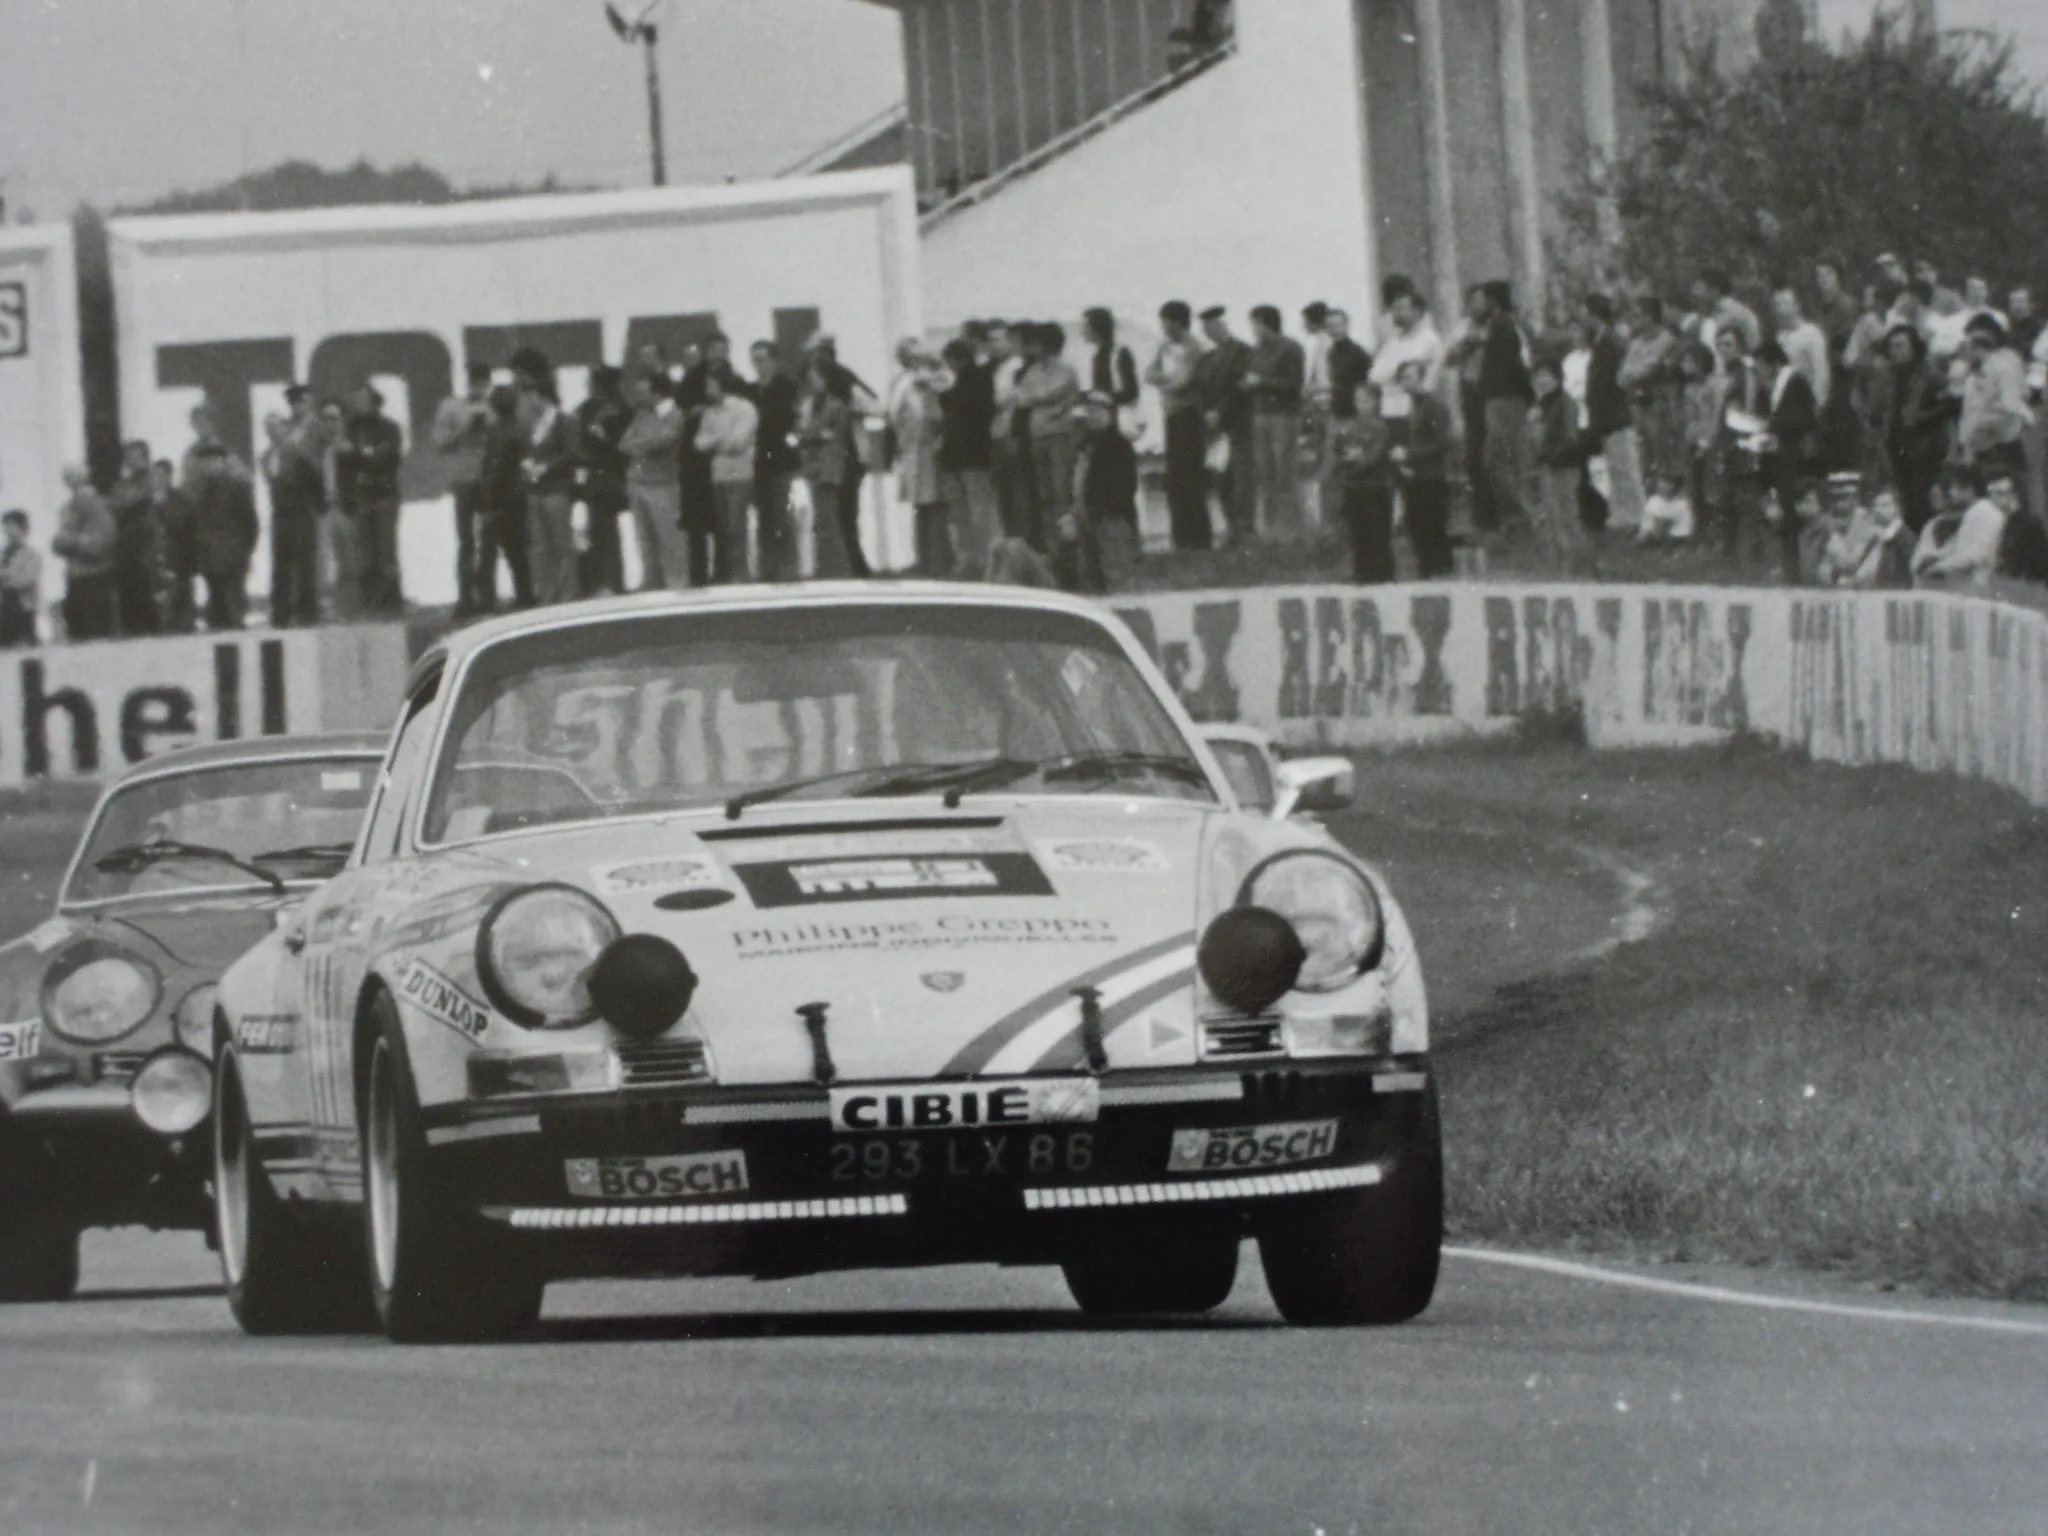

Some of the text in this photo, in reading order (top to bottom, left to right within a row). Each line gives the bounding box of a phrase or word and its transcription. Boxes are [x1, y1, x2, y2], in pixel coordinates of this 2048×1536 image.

[154, 306, 820, 504] TOT
[730, 913, 1111, 949] Philippe Greppo
[403, 969, 489, 1036] DUNLOP
[829, 1132, 1094, 1181] 293 LX 86
[1203, 1124, 1334, 1169] BOSCH
[600, 1159, 743, 1197] BOSCH
